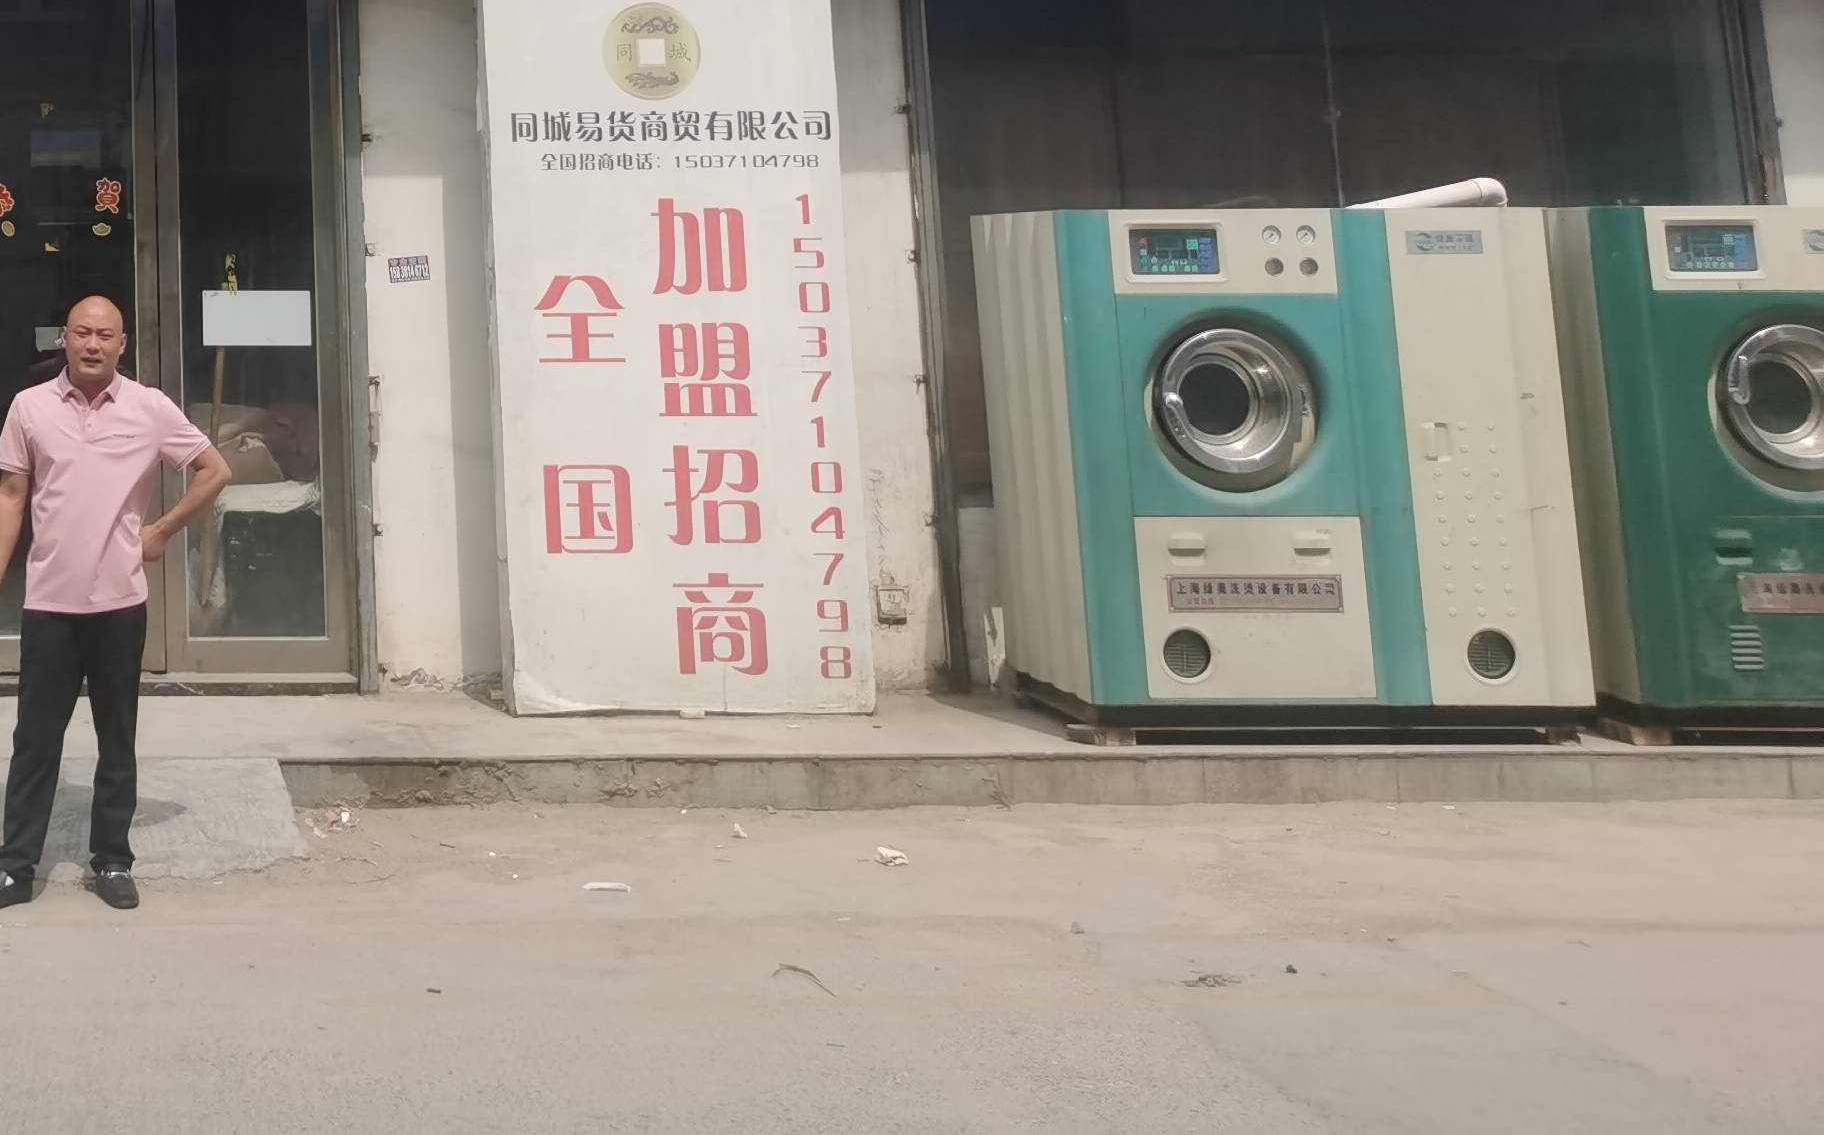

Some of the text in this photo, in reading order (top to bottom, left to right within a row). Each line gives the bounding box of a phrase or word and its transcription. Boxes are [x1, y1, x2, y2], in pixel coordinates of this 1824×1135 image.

[510, 109, 832, 144] 同城易货商贸有限公司
[616, 41, 691, 62] 同 城
[533, 275, 635, 554] 全国
[650, 197, 769, 676] 加盟招商
[793, 194, 852, 680] 15037104798
